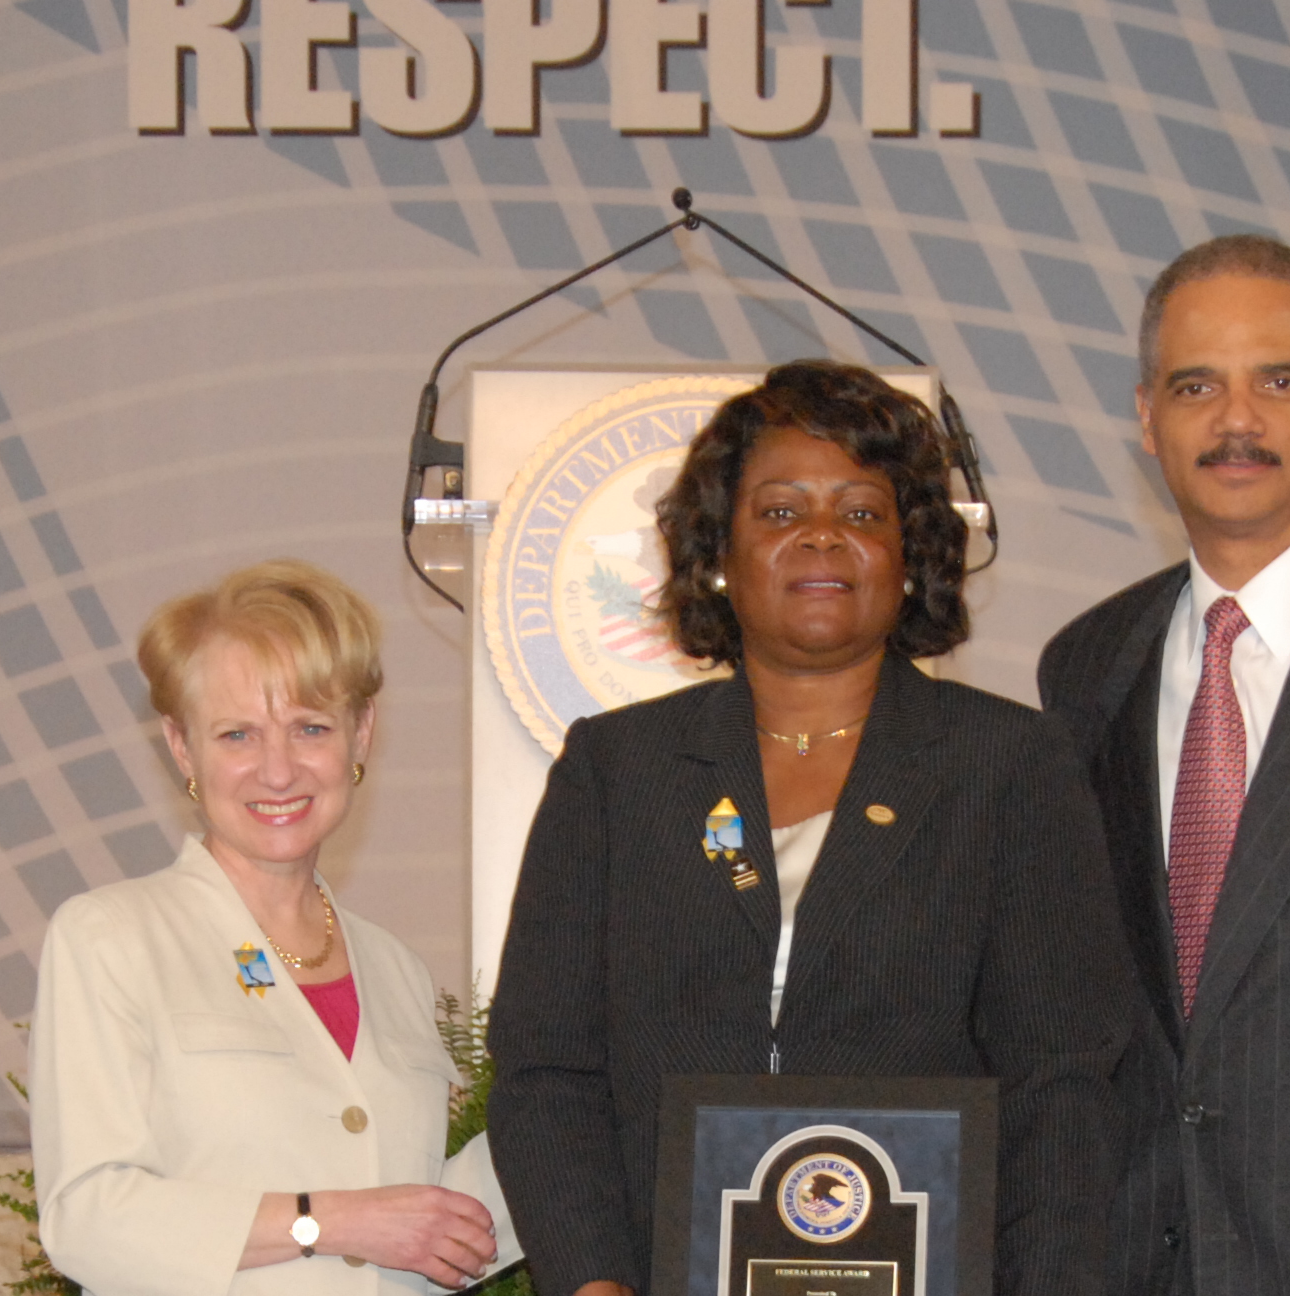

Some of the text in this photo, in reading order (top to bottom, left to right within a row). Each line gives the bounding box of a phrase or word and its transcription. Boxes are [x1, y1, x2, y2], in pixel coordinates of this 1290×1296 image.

[128, 0, 981, 140] RESPECT.
[514, 409, 713, 639] DEPARTMENT
[564, 580, 582, 618] QUI
[572, 628, 598, 666] PRO
[833, 1162, 848, 1174] OF
